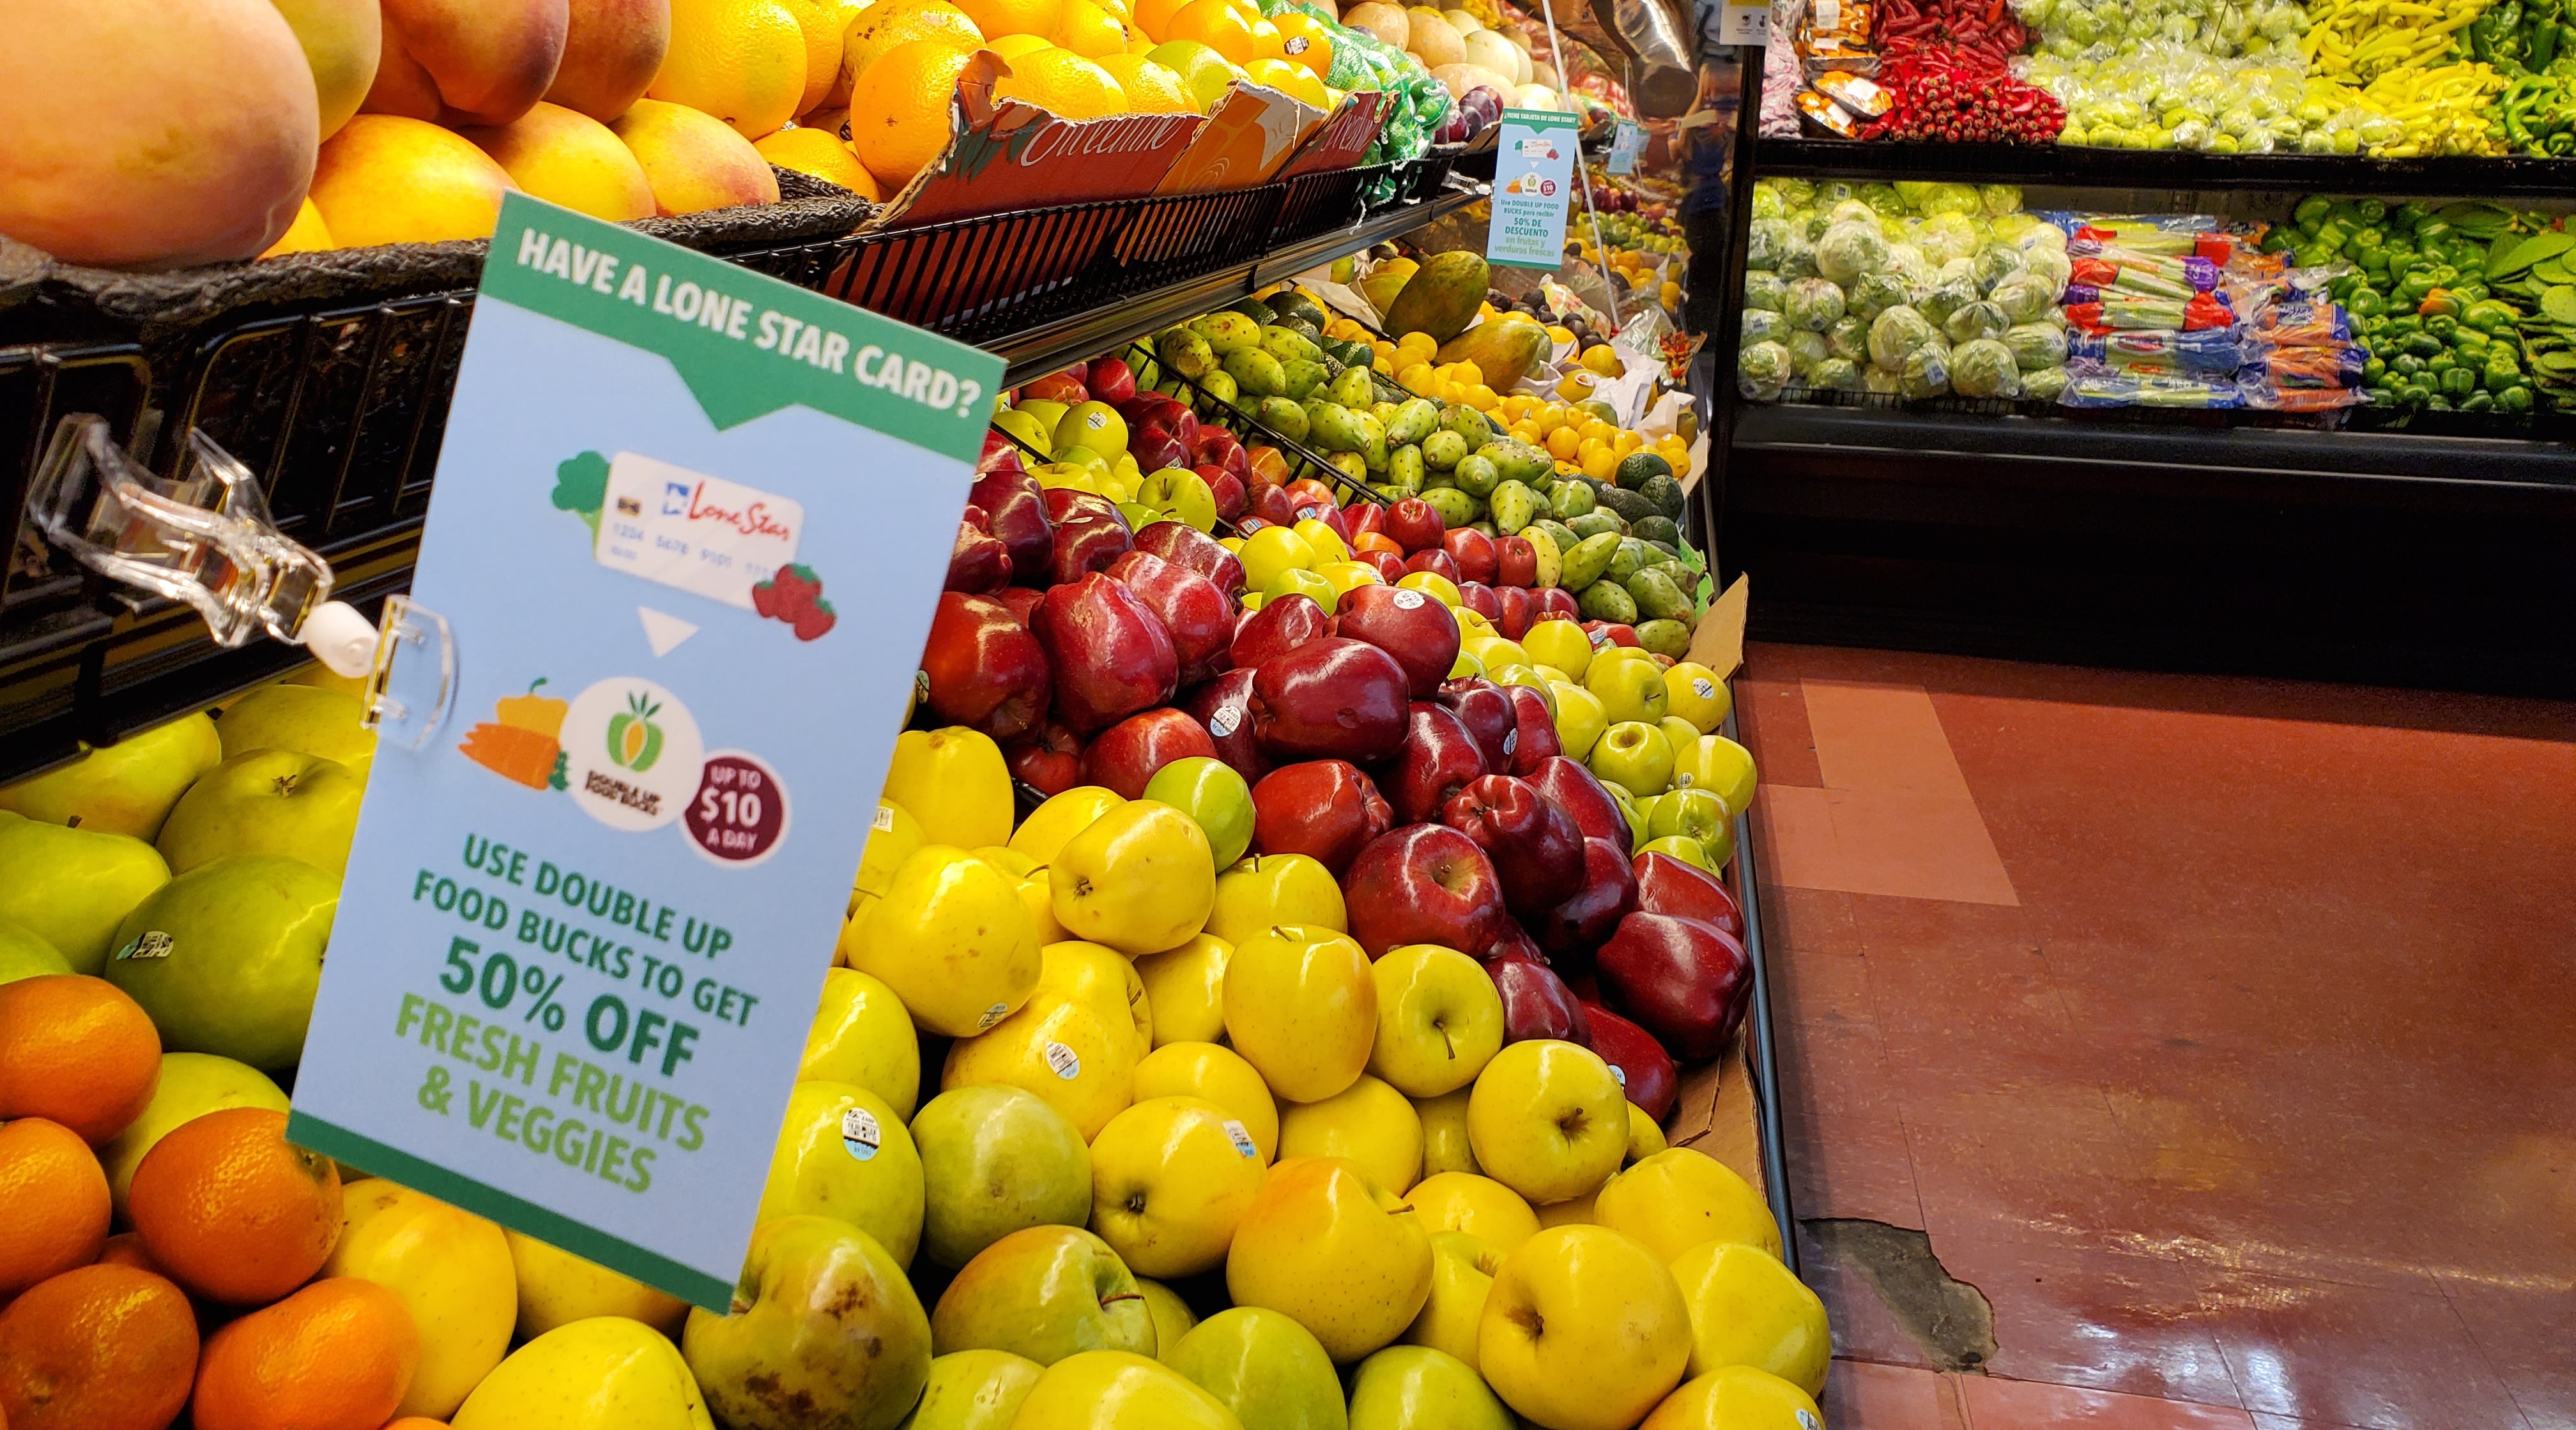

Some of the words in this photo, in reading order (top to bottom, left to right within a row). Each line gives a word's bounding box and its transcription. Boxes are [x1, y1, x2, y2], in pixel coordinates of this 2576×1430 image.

[1505, 226, 1548, 237] DESCUENTO
[1514, 218, 1529, 226] 50%
[1532, 219, 1542, 227] DE
[1517, 236, 1538, 246] frutas
[1541, 240, 1545, 248] y
[1495, 245, 1527, 254] verduras
[1529, 246, 1554, 257] frescas
[517, 228, 616, 295] HAVE
[619, 266, 646, 305] A
[652, 274, 754, 340] LONE
[754, 310, 849, 374] STAR
[855, 346, 981, 417] CARD?
[710, 766, 736, 784] UP
[738, 769, 762, 788] TO
[700, 786, 762, 827] $10
[707, 828, 719, 846] A
[722, 830, 758, 851] DAY
[463, 833, 528, 886] USE
[534, 862, 676, 941] DOUBLE
[682, 917, 733, 959] UP
[413, 869, 509, 931] FOOD
[516, 909, 634, 980] BUCKS
[641, 955, 684, 998] TO
[693, 977, 760, 1028] GET
[439, 936, 566, 1032] 50%
[585, 994, 700, 1077] OFF
[395, 992, 541, 1086] FRESH
[548, 1052, 710, 1152] FRUITS
[418, 1065, 454, 1115] &
[468, 1080, 657, 1193] VEGGIES
